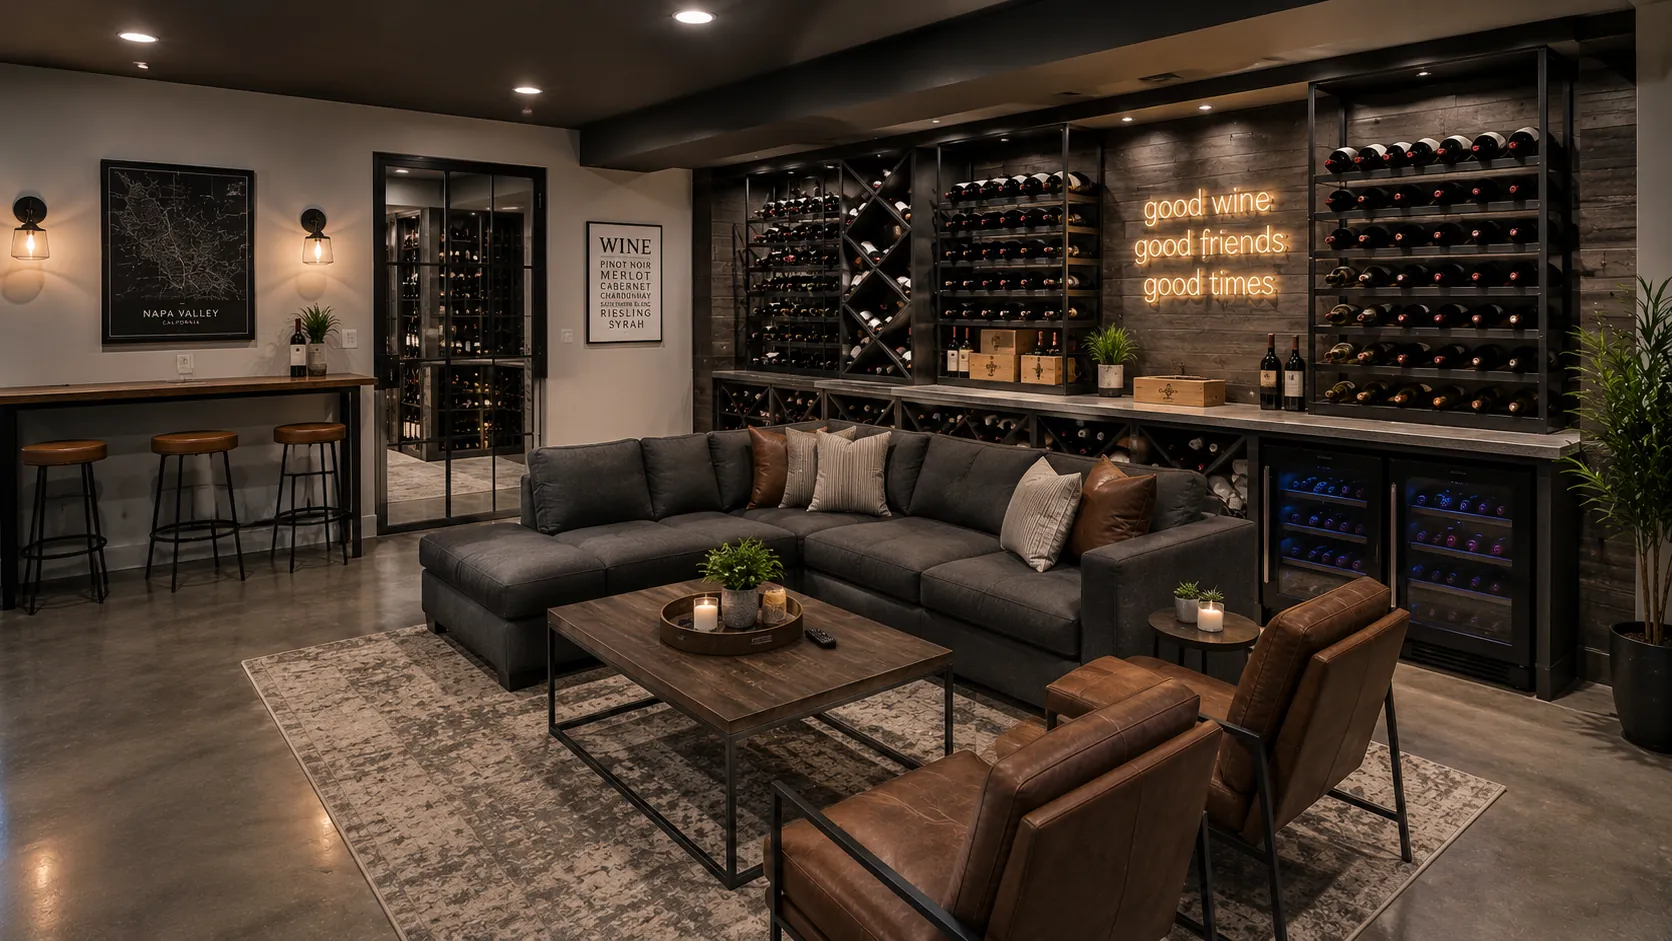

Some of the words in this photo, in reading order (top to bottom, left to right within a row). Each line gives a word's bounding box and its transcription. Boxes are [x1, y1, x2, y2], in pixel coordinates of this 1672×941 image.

[1144, 188, 1202, 227] good
[1212, 187, 1270, 214] wine
[599, 237, 652, 255] WINE
[1134, 229, 1191, 265] good
[1200, 225, 1285, 259] friends
[600, 260, 627, 269] PINOT
[630, 261, 651, 269] NOIR
[600, 270, 651, 281] MERLOT
[600, 282, 651, 291] CABERNET
[1143, 268, 1201, 303] good
[1210, 270, 1275, 296] times
[143, 309, 174, 318] NAPA
[178, 309, 219, 318] VALLEY
[600, 308, 651, 318] RIESLING
[609, 319, 644, 329] SYRAH
